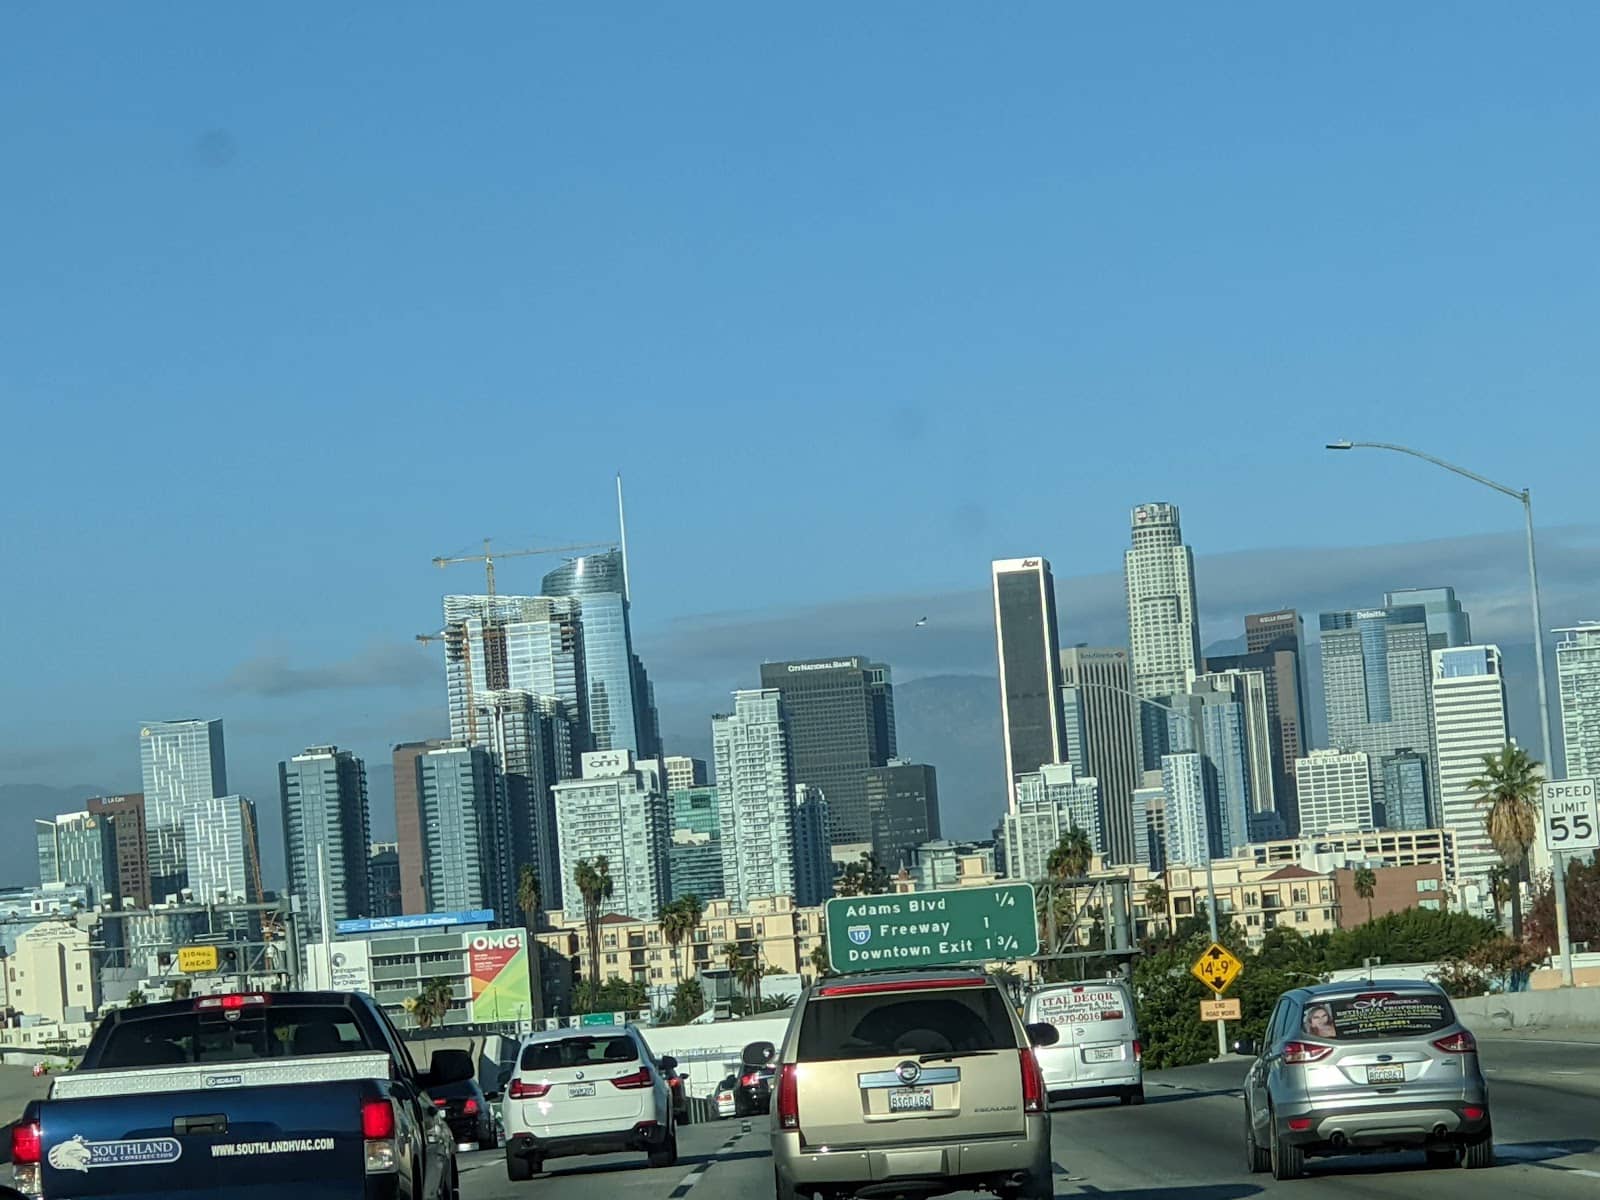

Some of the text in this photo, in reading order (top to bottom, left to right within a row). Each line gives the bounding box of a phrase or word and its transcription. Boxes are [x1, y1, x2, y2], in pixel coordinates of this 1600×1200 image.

[1322, 754, 1361, 764] WILSHIRE
[1547, 785, 1591, 798] SPEED
[1552, 802, 1587, 814] LIMIT
[1550, 814, 1592, 841] 55
[846, 906, 900, 918] Adams
[909, 898, 946, 912] Blvd
[854, 916, 989, 941] 10 Freeway 1
[473, 933, 523, 950] OMG!
[850, 944, 930, 961] Downtown
[939, 940, 973, 954] Exit
[986, 939, 991, 950] 1
[1200, 960, 1233, 976] 14'-9"
[1042, 992, 1113, 1006] ITAL DECOR
[92, 1142, 173, 1156] SOUTHLAND
[211, 1138, 334, 1157] WWW.SOUTHLANDHVAC.COM
